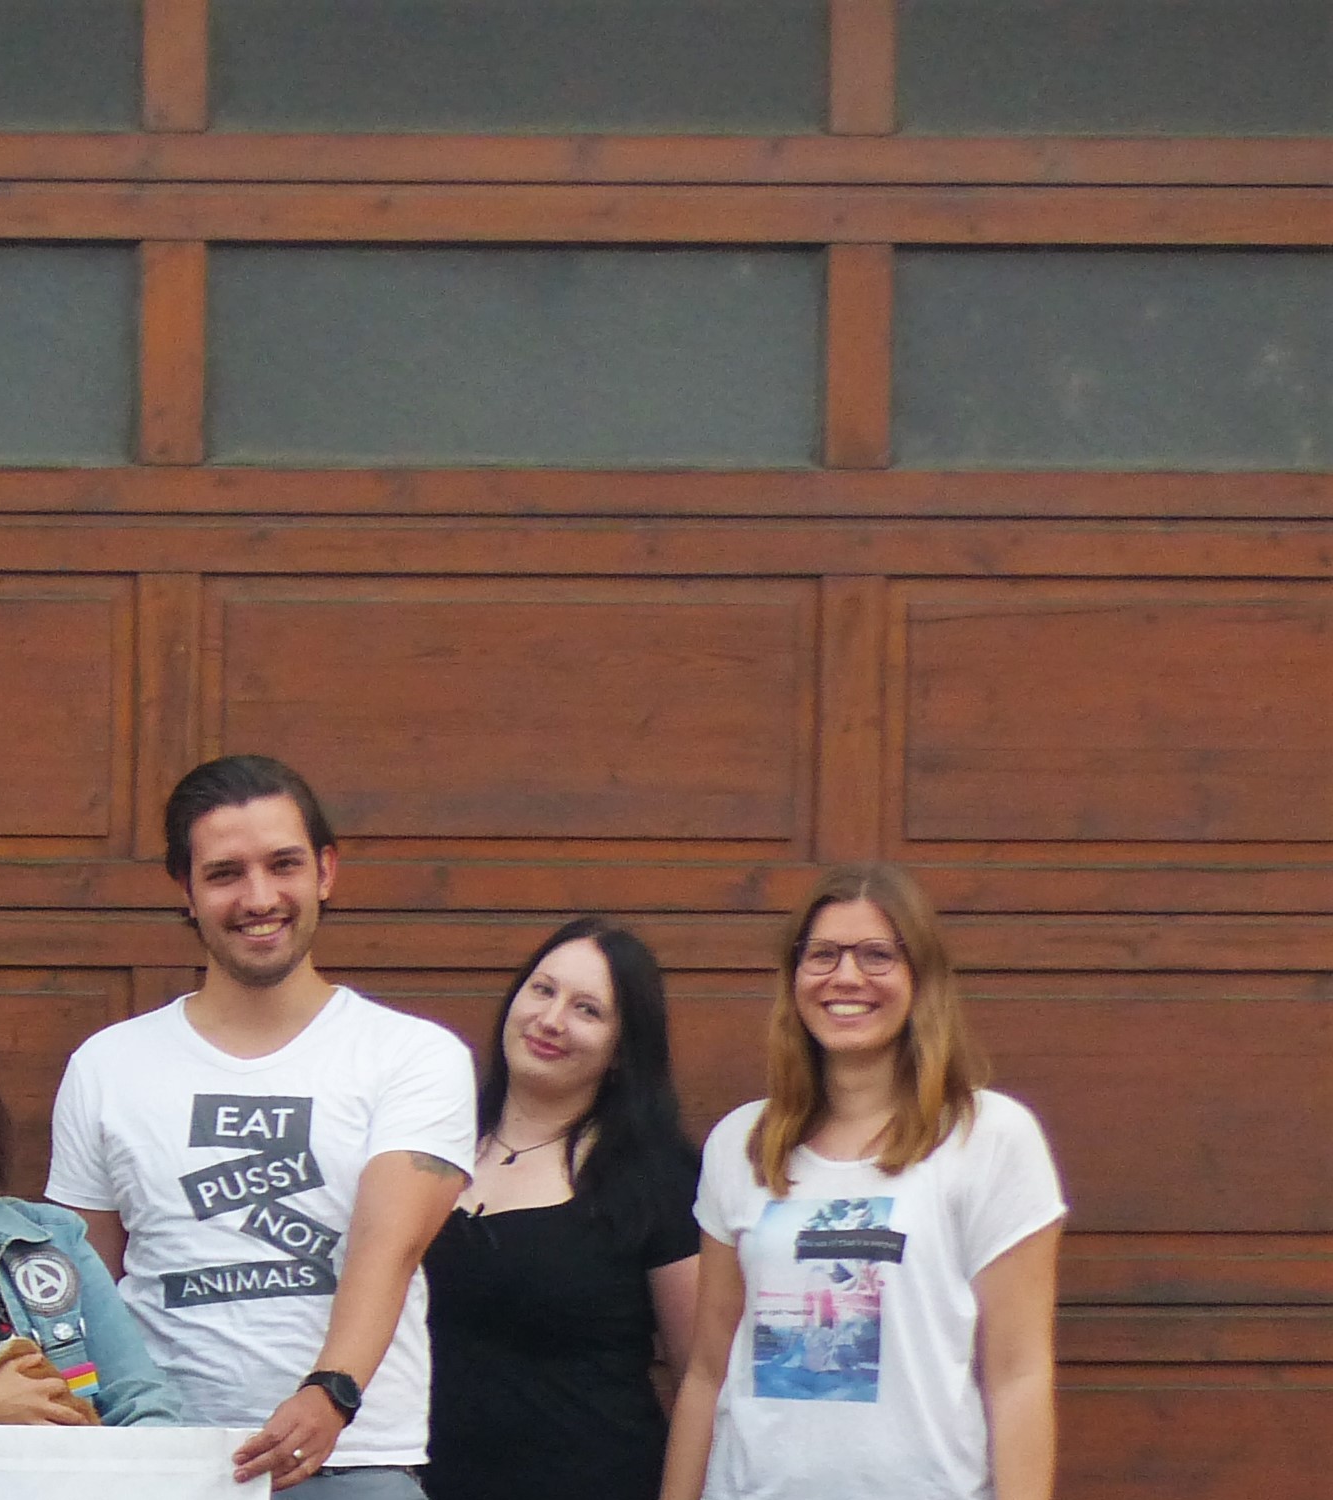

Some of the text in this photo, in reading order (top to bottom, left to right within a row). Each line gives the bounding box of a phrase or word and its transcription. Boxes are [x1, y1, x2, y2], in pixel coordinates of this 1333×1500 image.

[215, 1105, 295, 1139] EAT
[197, 1151, 309, 1209] PUSSY
[253, 1205, 330, 1255] NOT
[181, 1266, 317, 1298] ANIMALS
